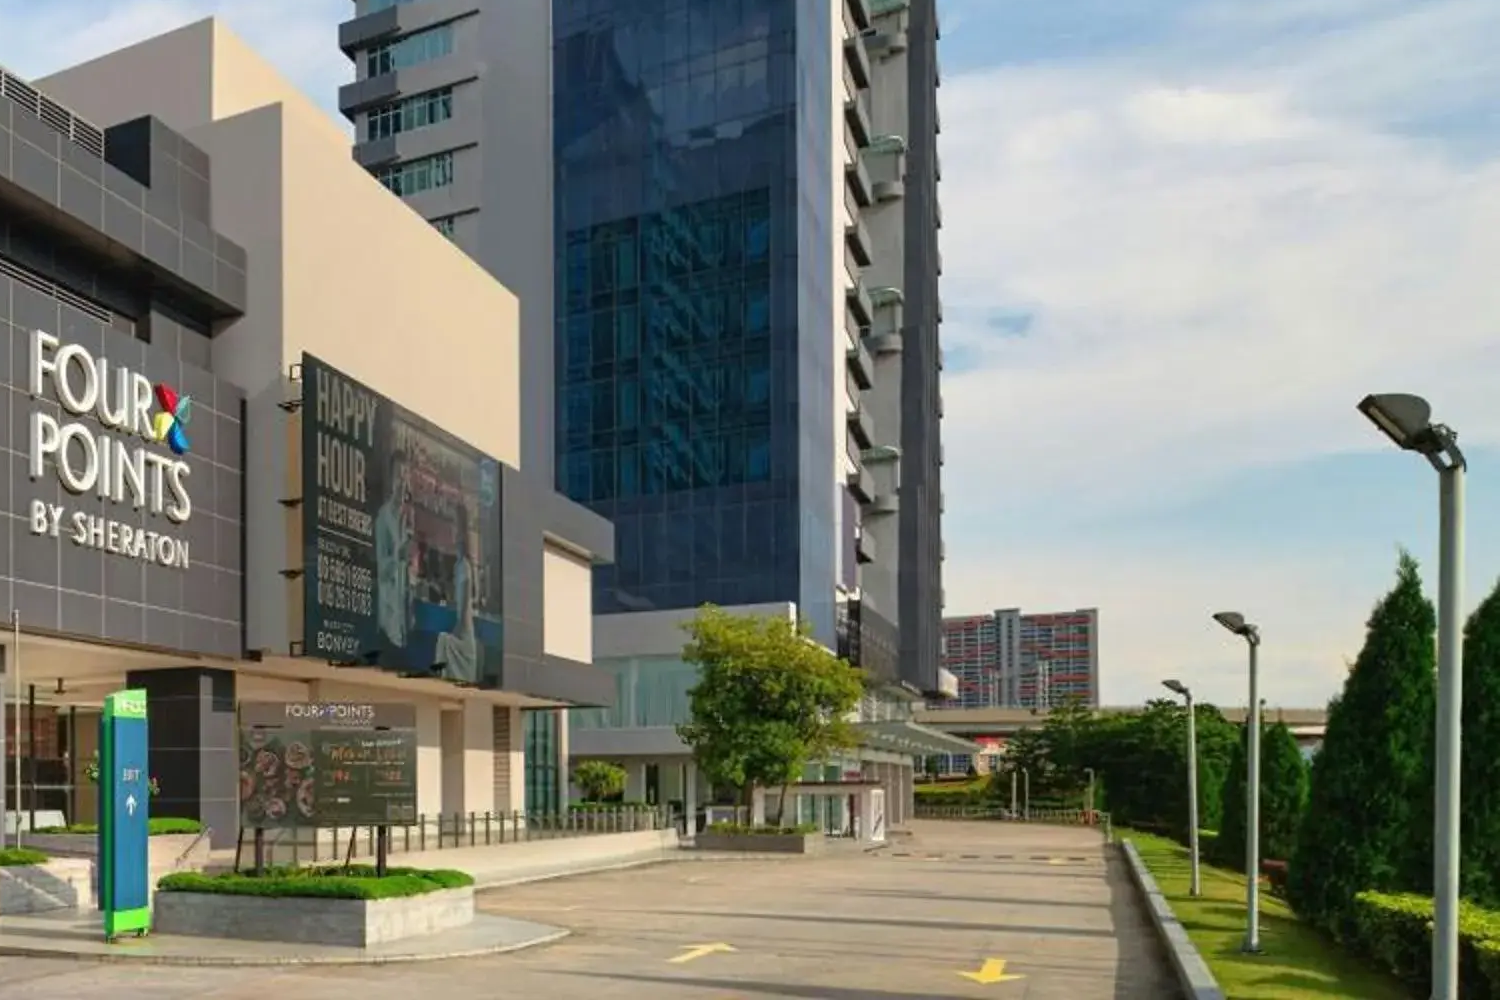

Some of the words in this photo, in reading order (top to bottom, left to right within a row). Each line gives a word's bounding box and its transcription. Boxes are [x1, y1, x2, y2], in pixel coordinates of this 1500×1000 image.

[29, 329, 156, 441] FOUR
[316, 367, 377, 448] HAPPY
[29, 411, 191, 522] POINTS
[317, 431, 366, 503] HOUR
[30, 499, 64, 537] BY
[72, 511, 190, 569] SHERATON
[285, 702, 320, 718] FOUR
[328, 703, 375, 719] POINTS
